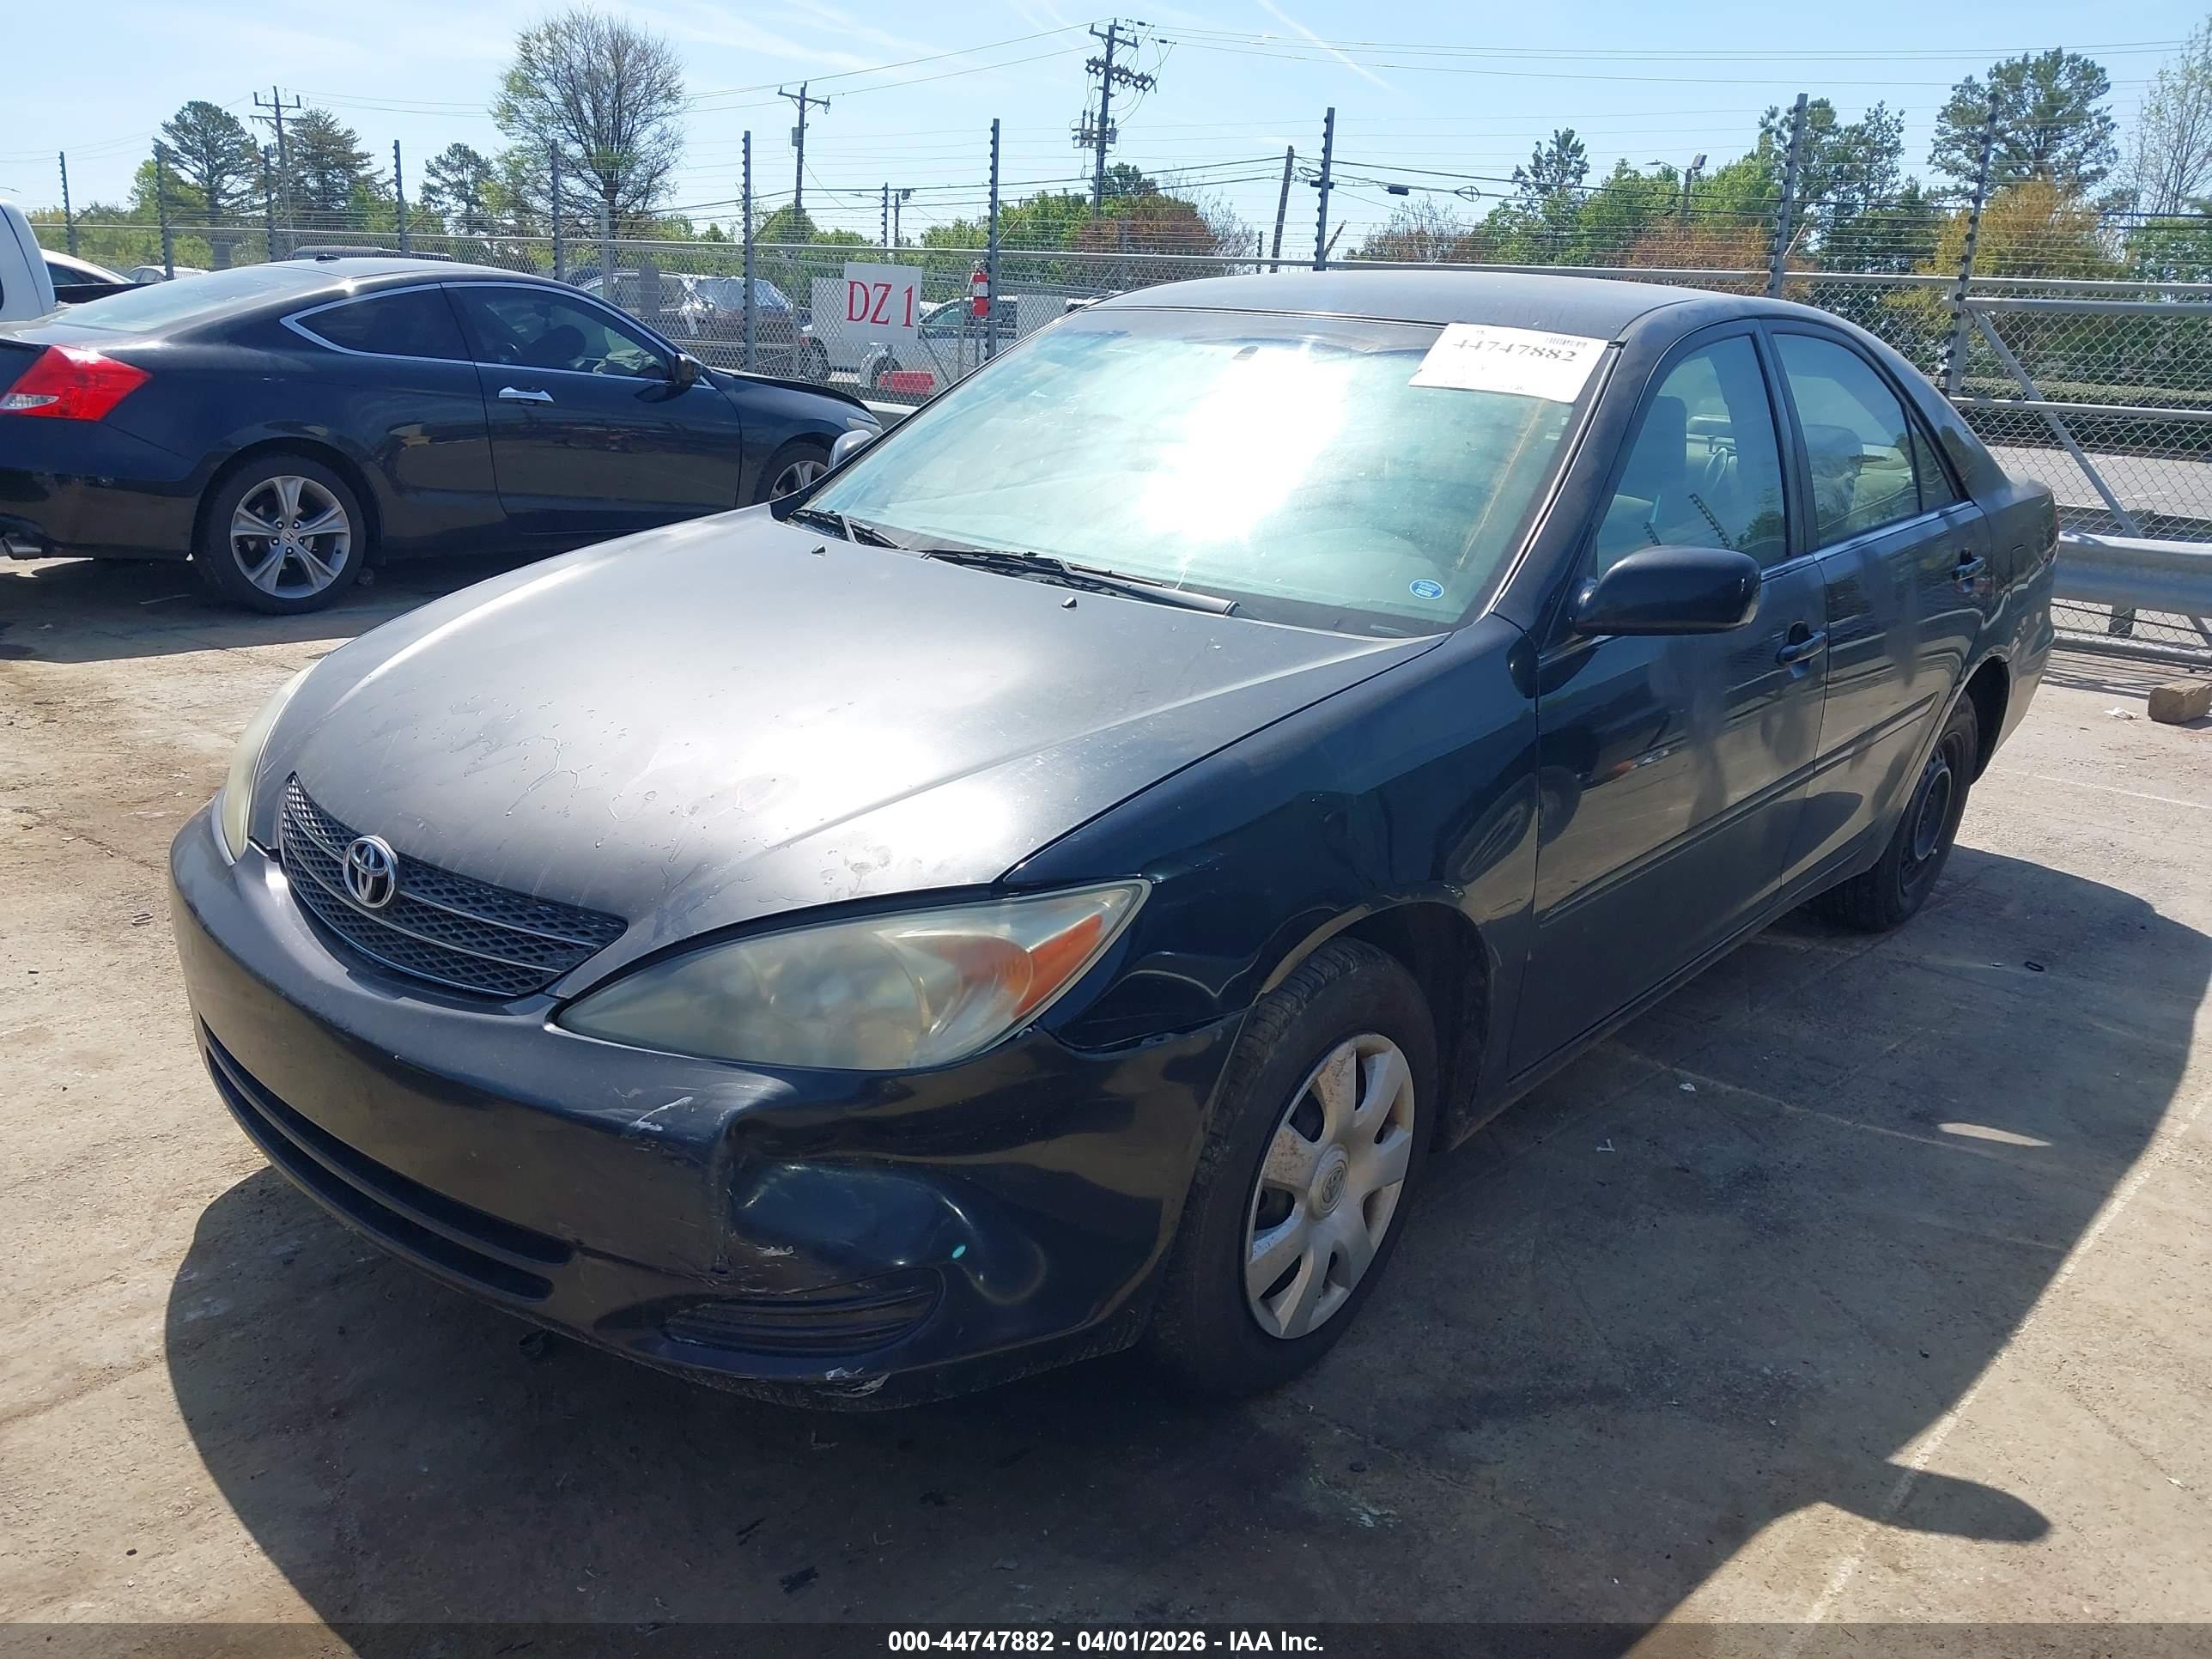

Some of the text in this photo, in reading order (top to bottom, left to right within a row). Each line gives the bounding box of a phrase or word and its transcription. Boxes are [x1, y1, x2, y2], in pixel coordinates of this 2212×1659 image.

[846, 280, 915, 328] DZ 1
[1452, 339, 1577, 362] 44747882
